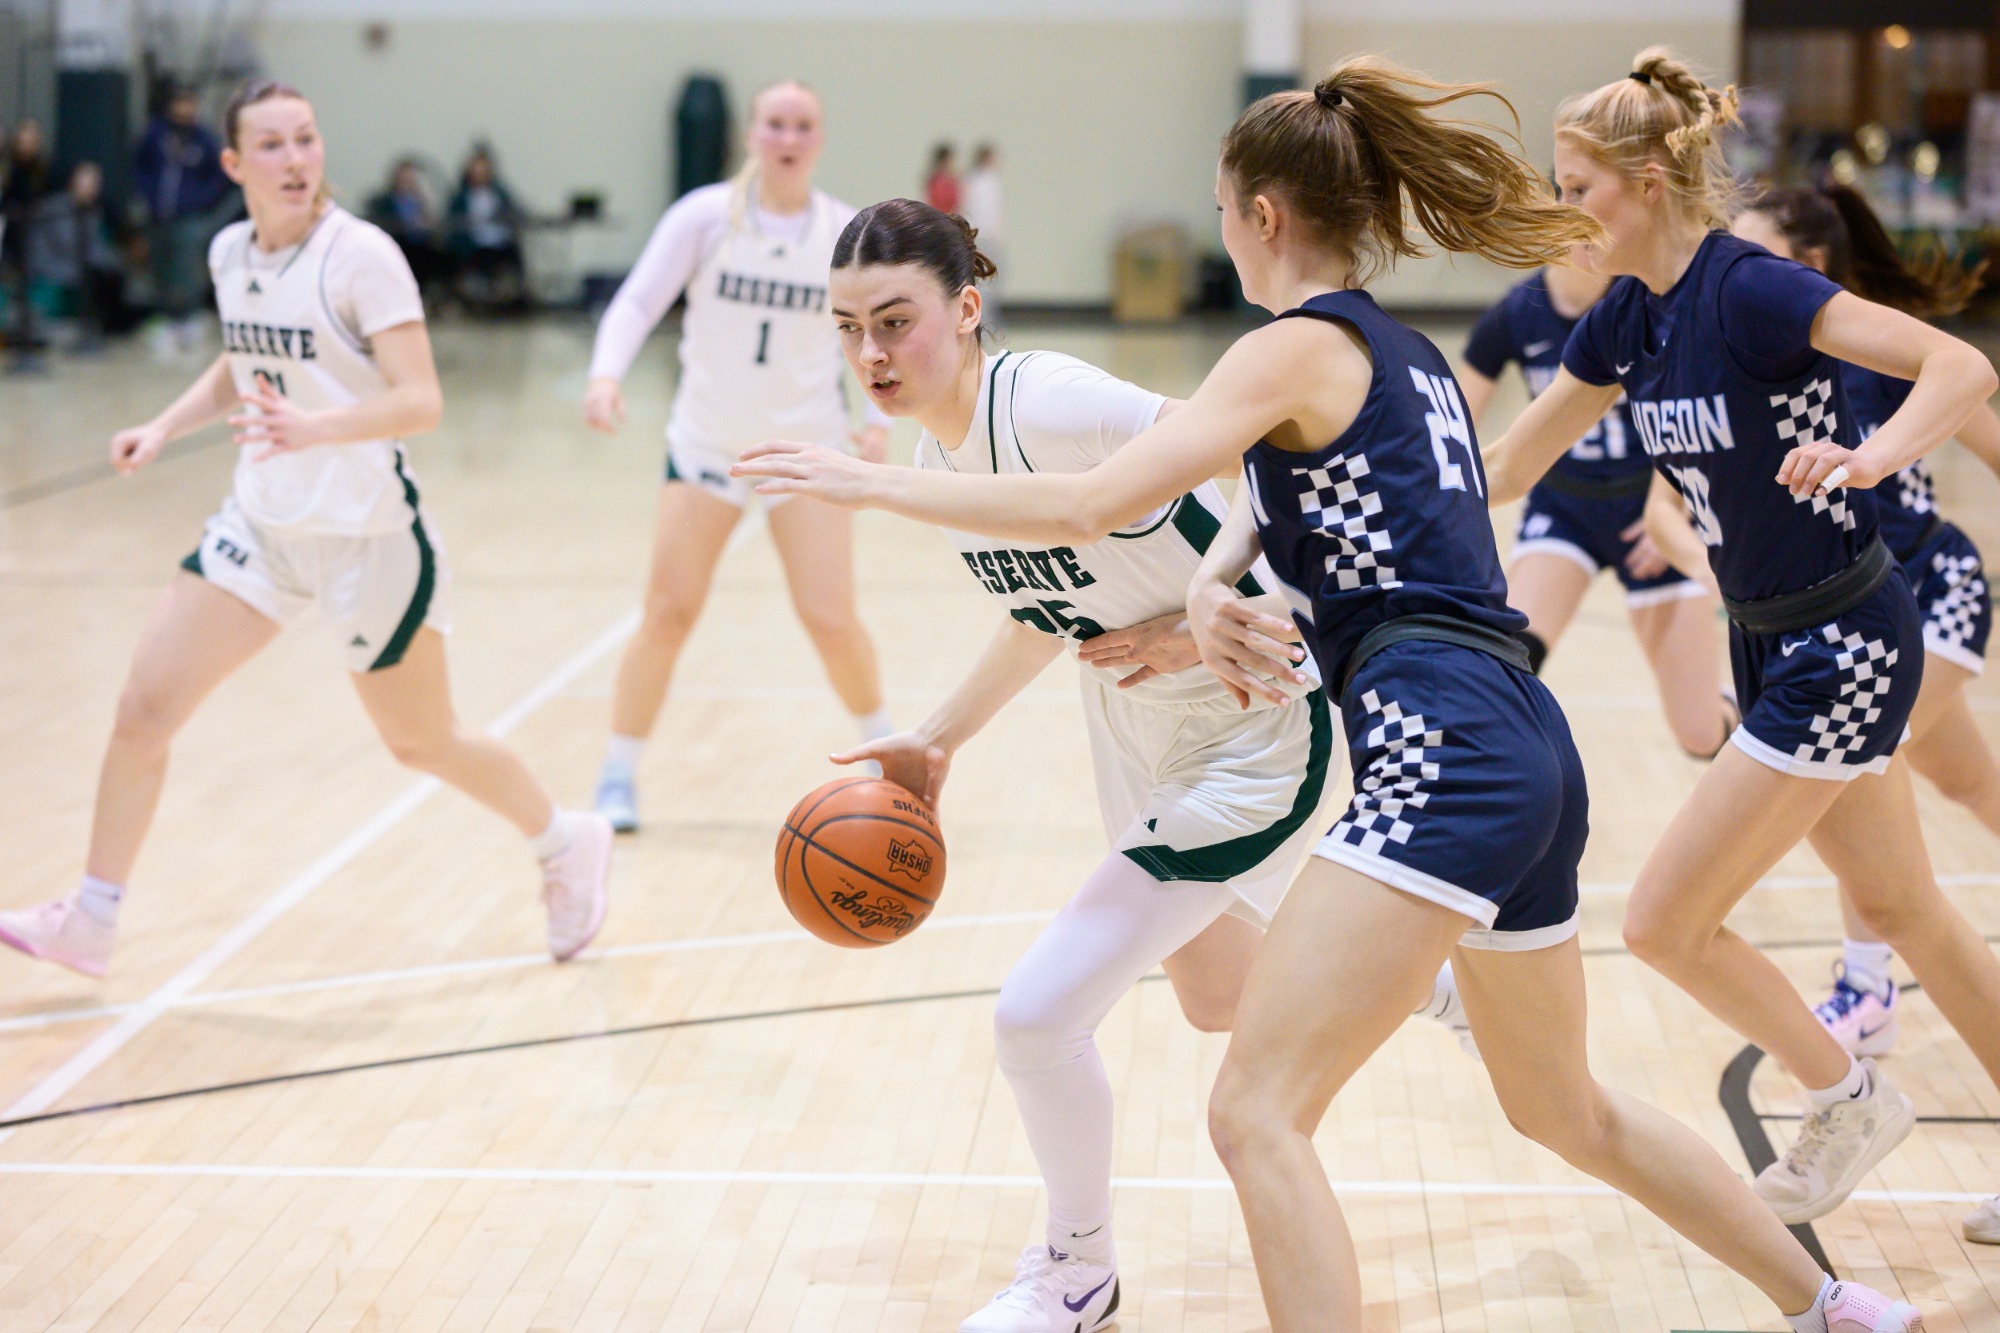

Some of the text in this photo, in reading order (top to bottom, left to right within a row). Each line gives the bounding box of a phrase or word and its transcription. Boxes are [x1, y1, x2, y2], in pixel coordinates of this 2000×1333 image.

[226, 321, 316, 359] ESERVE
[757, 320, 770, 364] 1
[1408, 365, 1484, 500] 24
[1630, 393, 1735, 456] UDSON
[960, 546, 1097, 595] ESERVE
[891, 843, 931, 873] OHSAA
[831, 890, 926, 937] Rawlings
